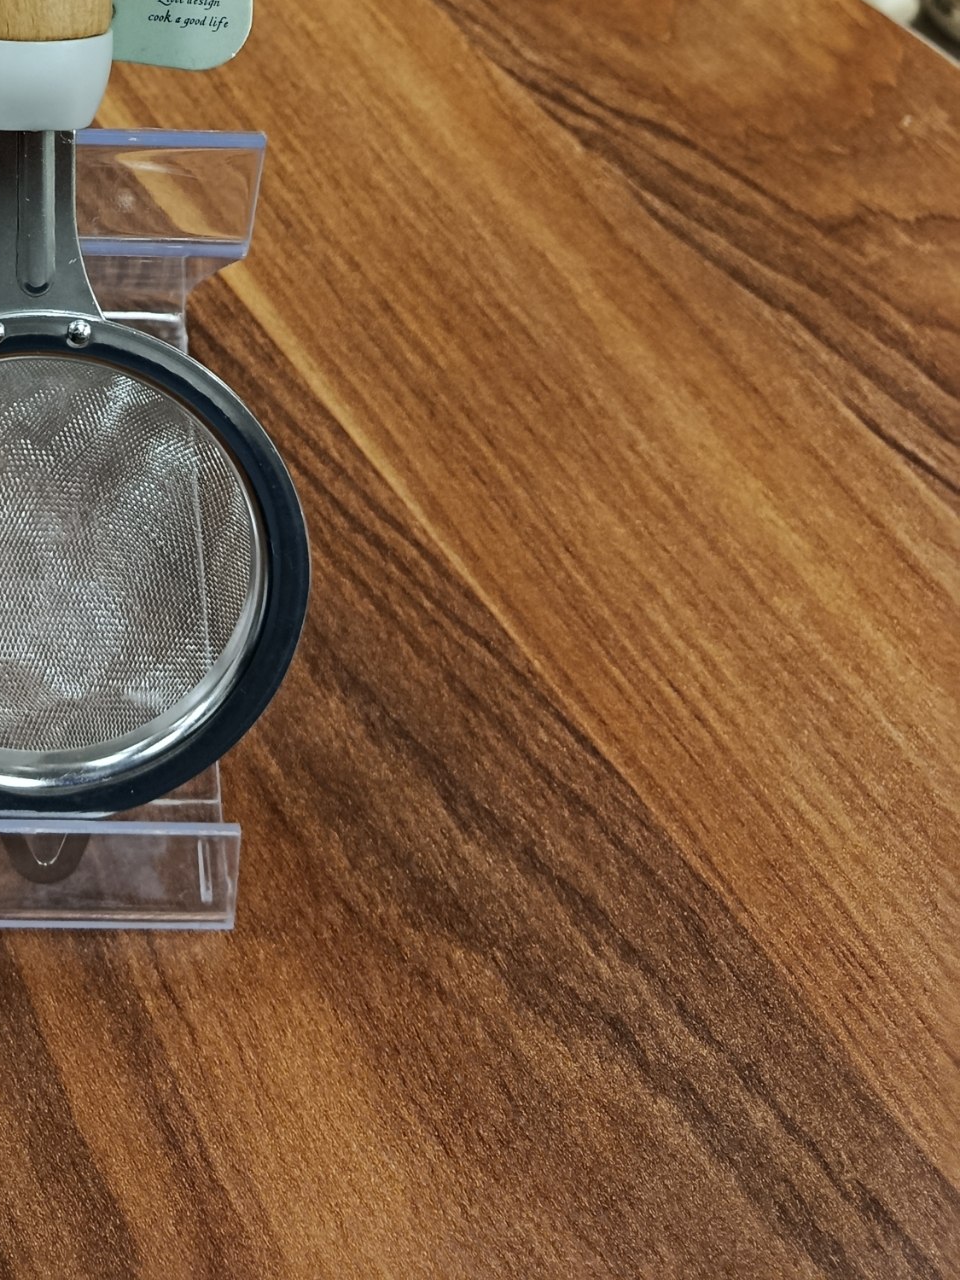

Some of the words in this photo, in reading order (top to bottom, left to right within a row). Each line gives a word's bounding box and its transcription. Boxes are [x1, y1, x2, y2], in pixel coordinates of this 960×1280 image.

[147, 9, 172, 23] cook
[179, 15, 207, 29] good
[208, 15, 230, 33] life
